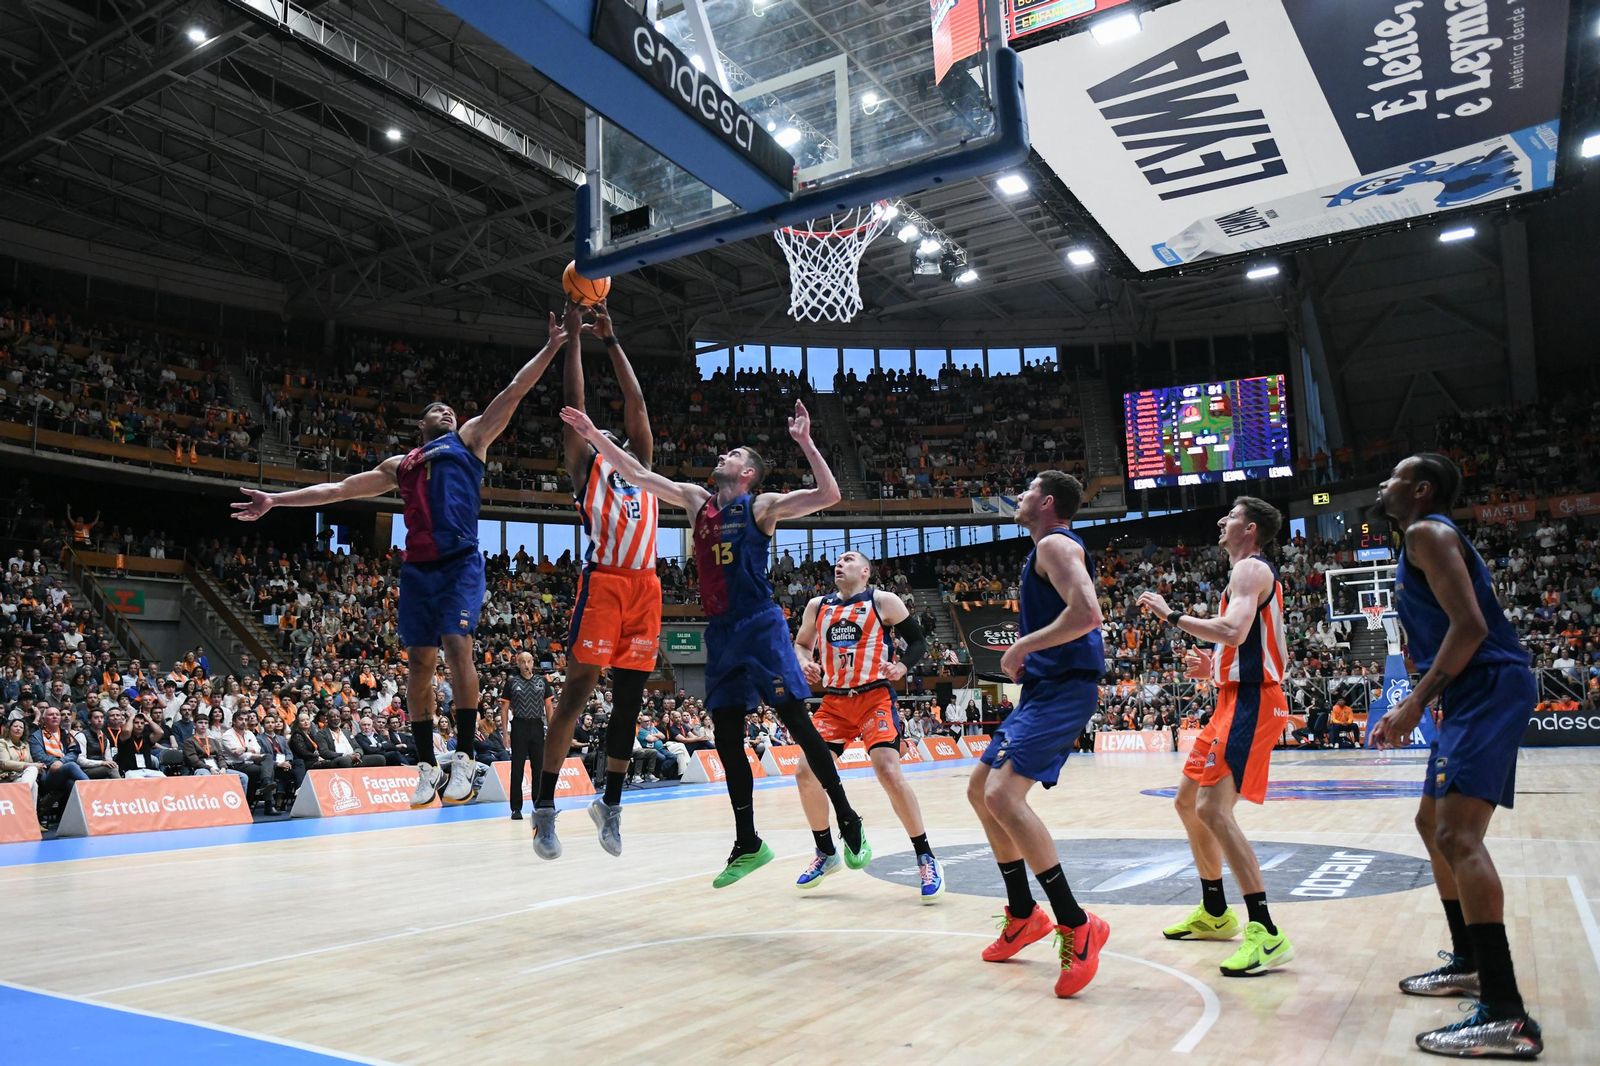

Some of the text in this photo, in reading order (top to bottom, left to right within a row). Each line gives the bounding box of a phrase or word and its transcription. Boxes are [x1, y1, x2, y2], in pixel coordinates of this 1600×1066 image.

[1506, 7, 1525, 40] dende
[1363, 0, 1424, 91] leite,
[1508, 44, 1524, 90] Auténtica
[634, 27, 753, 151] endesa
[1086, 20, 1288, 201] LEYMA
[1215, 206, 1271, 237] LEYMA
[625, 500, 641, 519] 12
[1361, 534, 1382, 547] 24
[711, 542, 734, 566] 13
[831, 626, 856, 634] Estrella
[831, 633, 855, 641] Galicia
[983, 630, 1020, 638] Estre
[986, 636, 1018, 645] Gal
[1528, 714, 1600, 731] ndesa
[1102, 735, 1147, 750] LEYMA
[91, 795, 221, 817] Estrella Galicia
[368, 790, 410, 805] lenda
